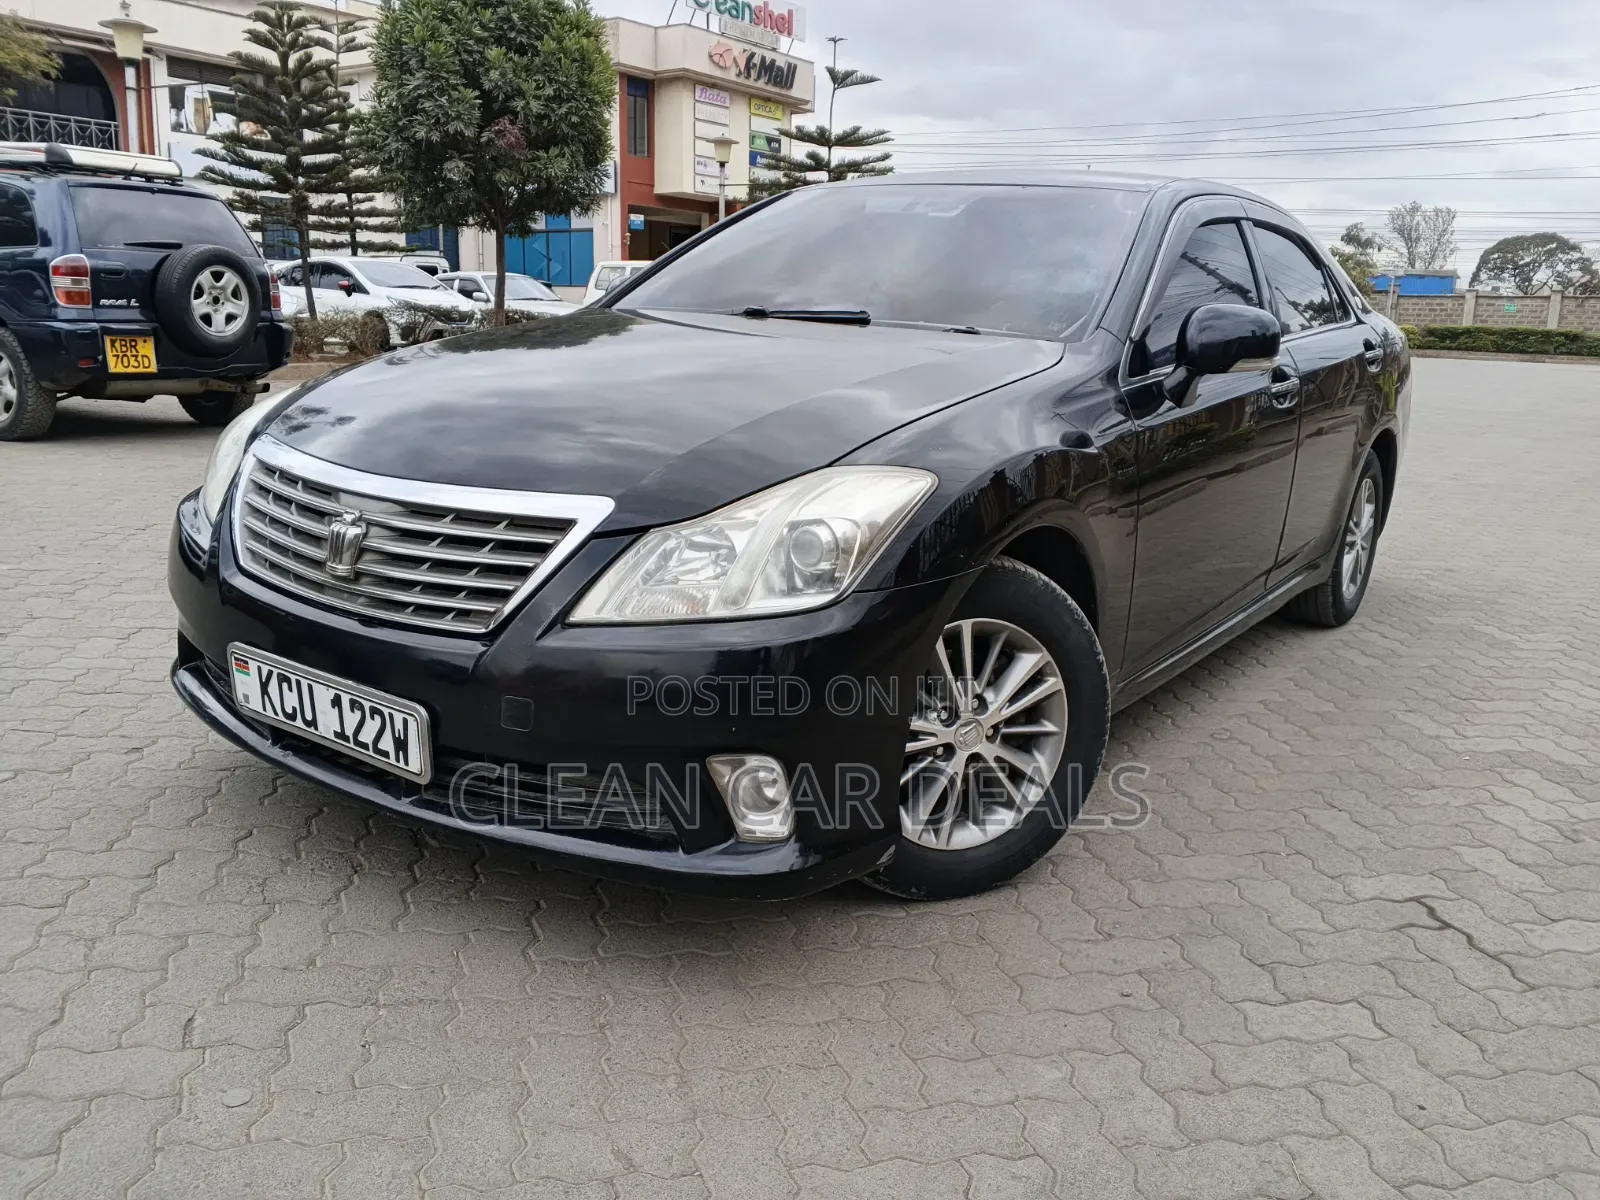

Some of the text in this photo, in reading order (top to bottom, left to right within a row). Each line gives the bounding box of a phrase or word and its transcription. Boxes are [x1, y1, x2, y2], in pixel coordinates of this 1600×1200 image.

[698, 86, 728, 105] Bata
[109, 338, 139, 353] KBR
[112, 354, 151, 369] 703D
[257, 664, 409, 766] KCU 122W
